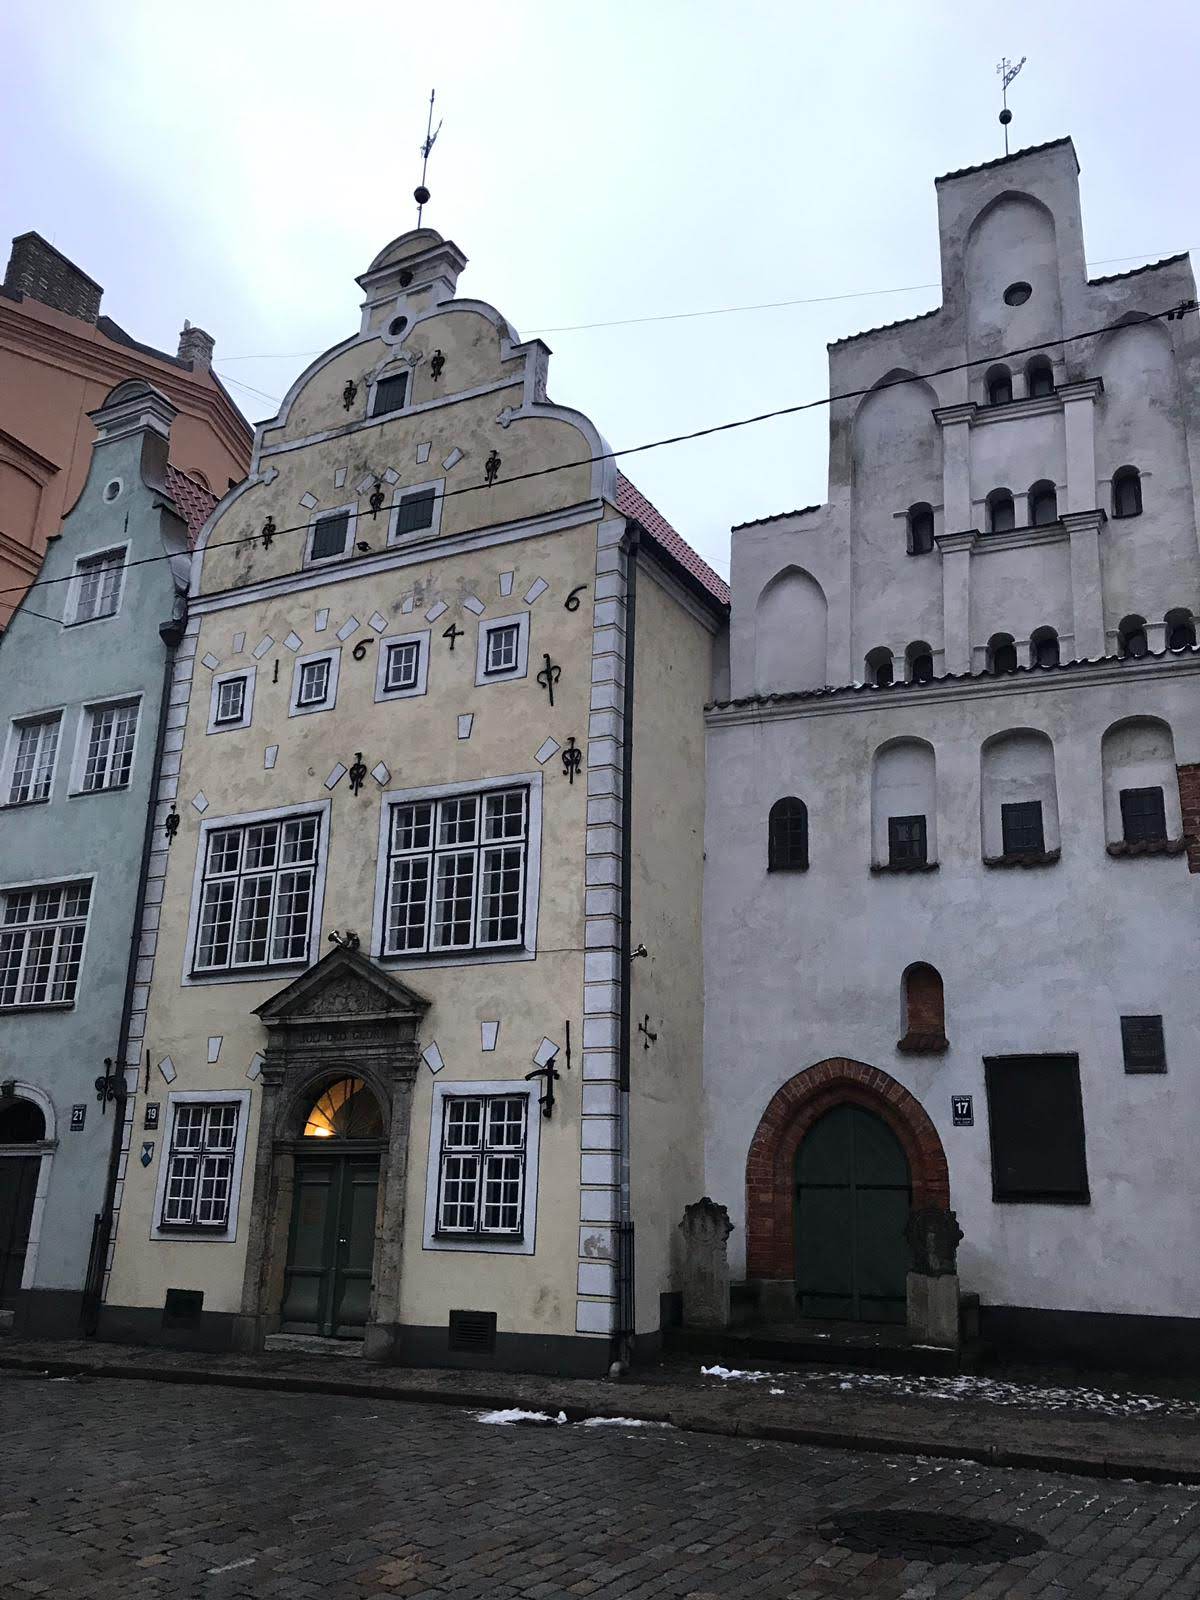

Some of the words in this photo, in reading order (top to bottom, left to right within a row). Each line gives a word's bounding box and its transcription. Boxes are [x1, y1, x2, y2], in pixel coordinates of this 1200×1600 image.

[352, 638, 374, 661] 6
[442, 623, 464, 650] 4
[564, 585, 587, 612] 6
[147, 1108, 157, 1119] 19
[955, 1102, 969, 1114] 17
[73, 1110, 83, 1121] 21
